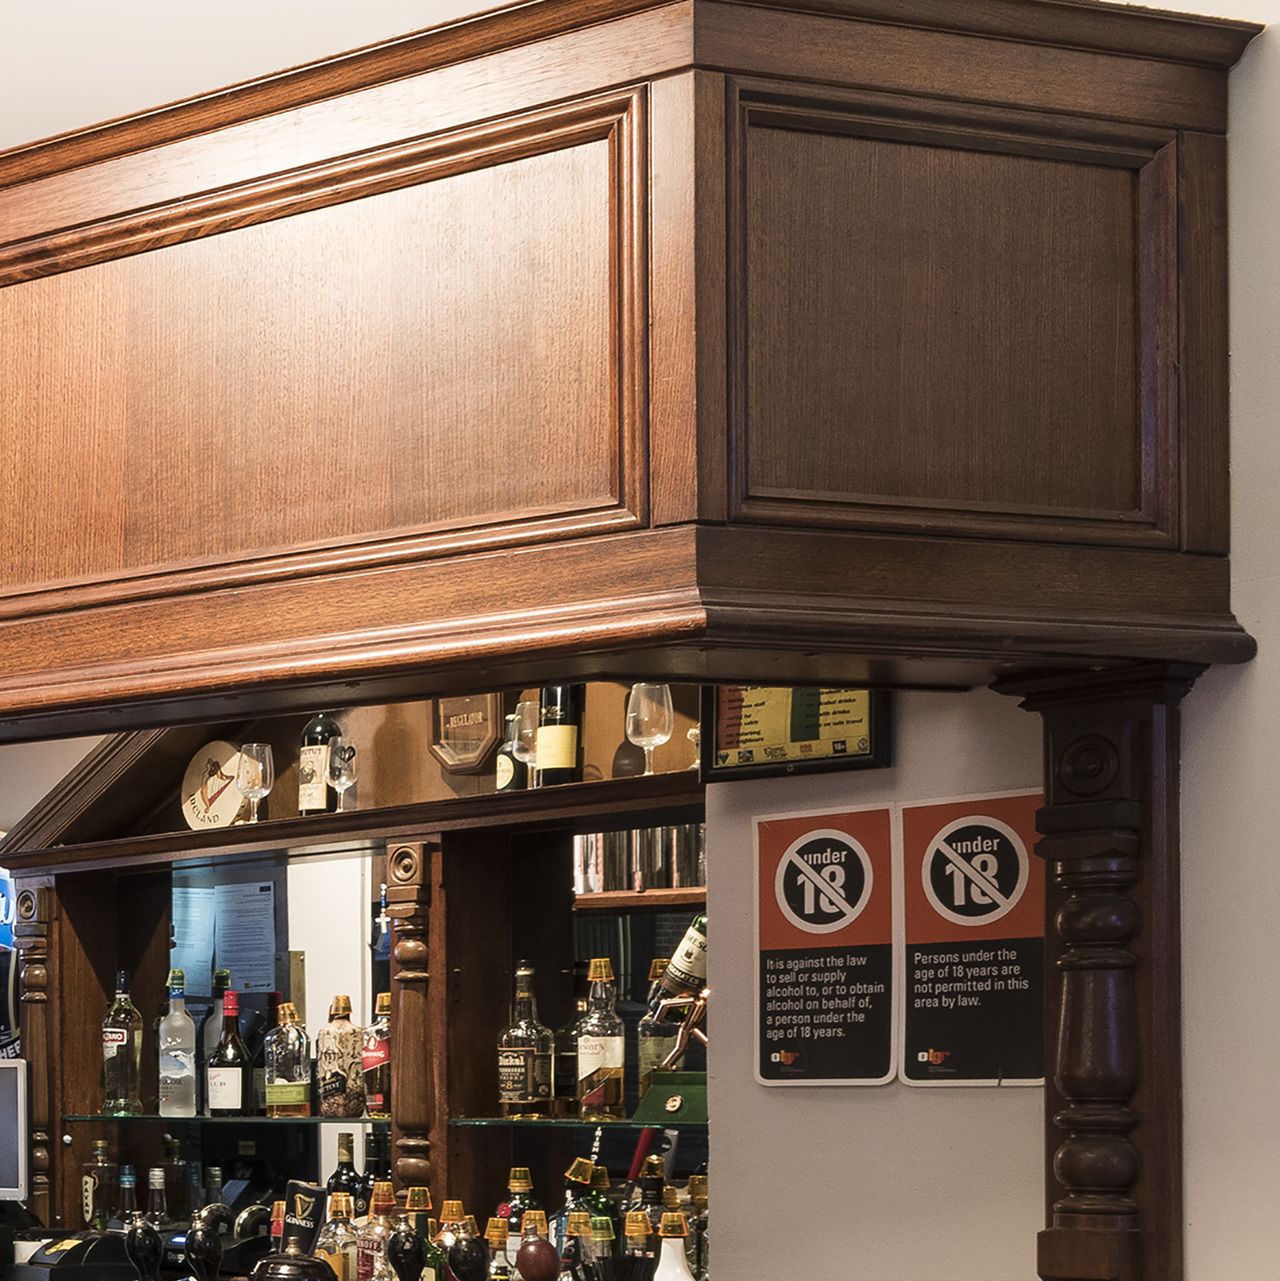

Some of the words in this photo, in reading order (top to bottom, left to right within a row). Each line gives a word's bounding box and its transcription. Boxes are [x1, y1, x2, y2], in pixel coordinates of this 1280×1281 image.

[449, 711, 484, 728] REGULATOR
[189, 793, 220, 824] IRELAND
[952, 836, 1000, 854] under
[803, 848, 847, 865] under
[945, 853, 999, 906] 18
[796, 864, 846, 915] 18
[766, 959, 774, 970] It
[775, 958, 784, 970] is
[786, 957, 825, 971] against
[826, 956, 844, 967] the
[846, 955, 867, 966] law
[914, 952, 959, 965] Persons
[962, 949, 995, 962] under
[997, 948, 1017, 960] the
[766, 973, 777, 984] to
[779, 972, 796, 983] sell
[798, 973, 809, 982] or
[811, 970, 846, 983] supply
[914, 969, 935, 981] age
[937, 966, 949, 978] of
[952, 966, 964, 977] 18
[966, 966, 999, 979] years
[1001, 965, 1020, 975] are
[766, 986, 803, 997] alcohol
[806, 986, 820, 997] to,
[822, 987, 833, 995] or
[836, 985, 847, 995] to
[849, 982, 884, 994] obtain
[914, 983, 932, 993] not
[935, 979, 991, 995] permitted
[994, 978, 1005, 990] in
[1007, 976, 1029, 990] this
[766, 999, 803, 1011] alcohol
[806, 1000, 819, 1010] on
[822, 997, 856, 1009] behalf
[858, 996, 873, 1009] of,
[914, 998, 939, 1008] area
[941, 995, 955, 1009] by
[958, 995, 981, 1007] law.
[766, 1015, 773, 1025] a
[775, 1014, 811, 1027] person
[813, 1012, 845, 1024] under
[847, 1011, 865, 1022] the
[766, 1029, 784, 1041] age
[786, 1026, 798, 1038] of
[800, 1027, 811, 1038] 18
[813, 1027, 846, 1040] years.
[285, 1213, 315, 1229] GUINNESS
